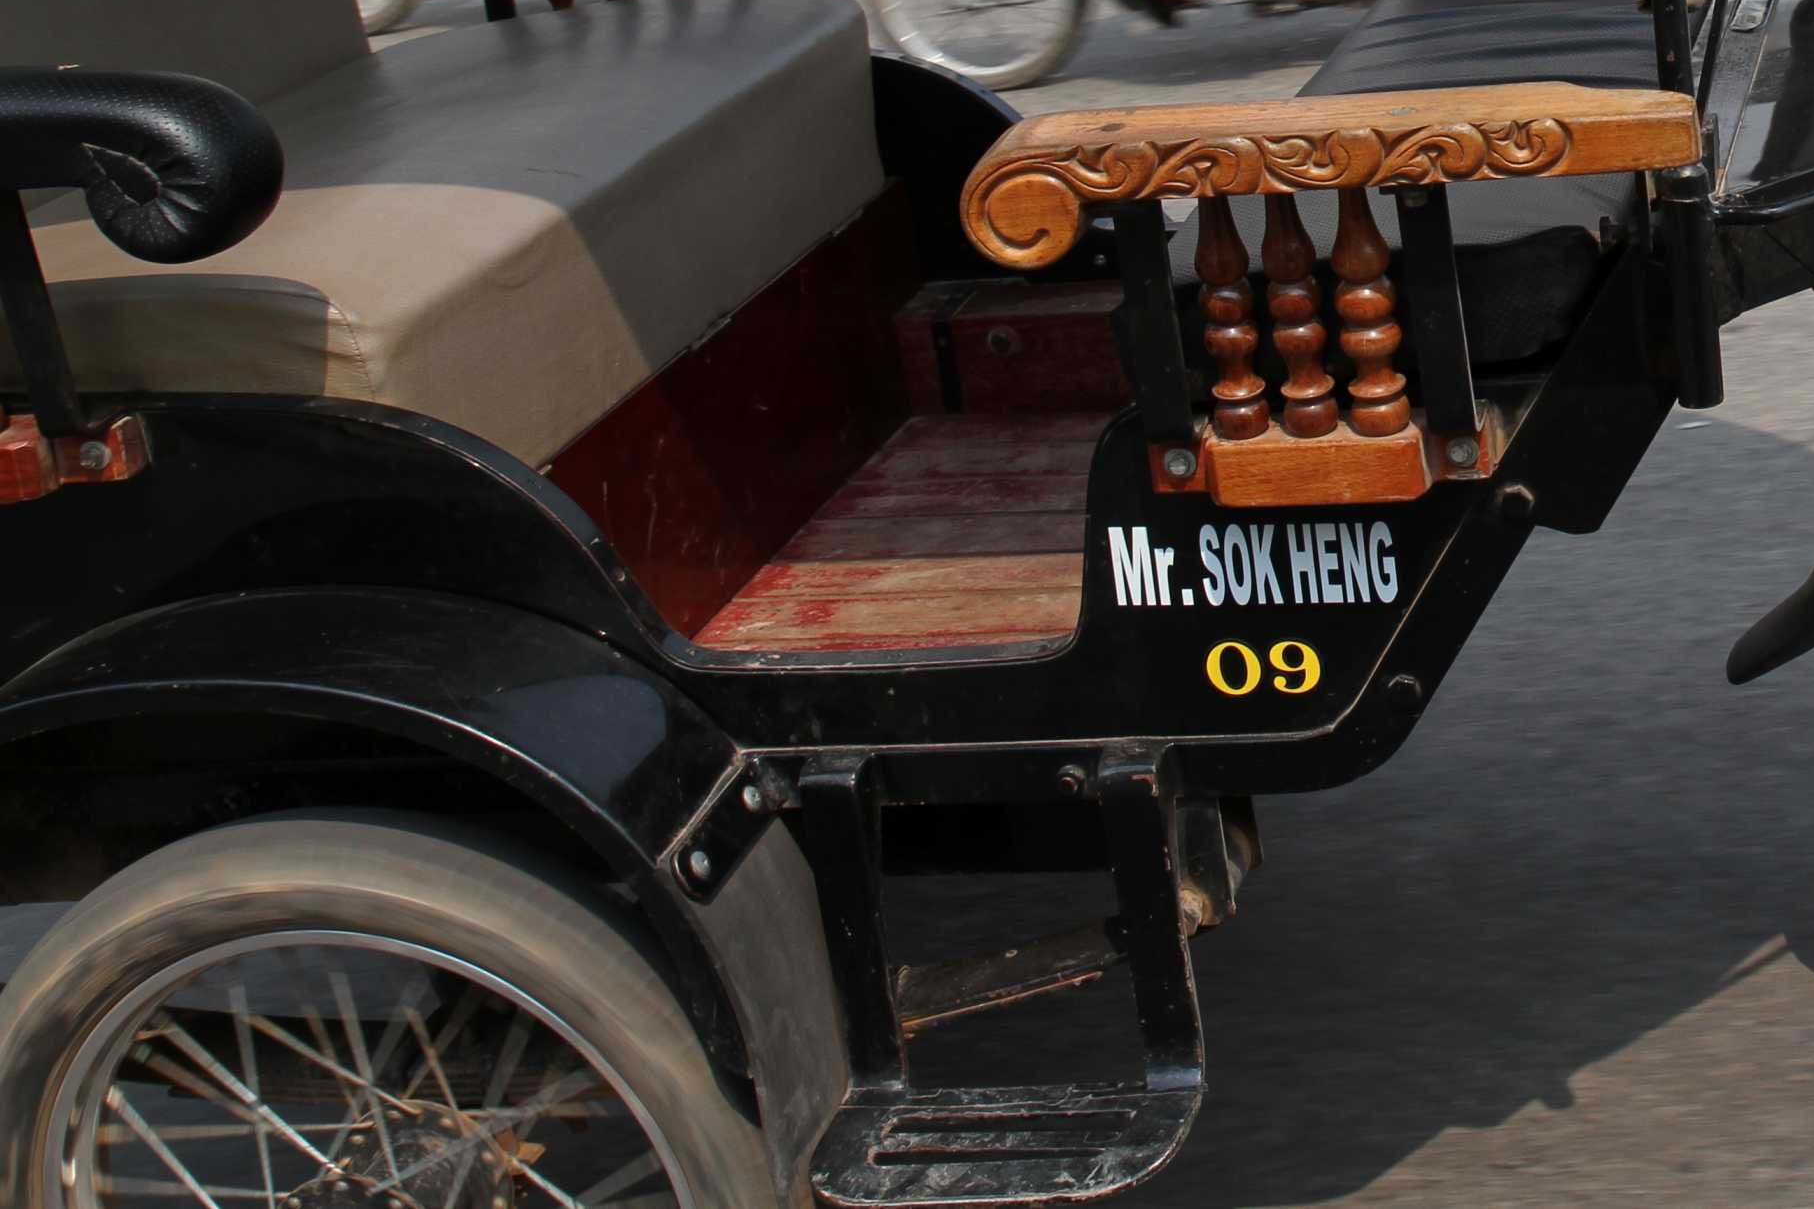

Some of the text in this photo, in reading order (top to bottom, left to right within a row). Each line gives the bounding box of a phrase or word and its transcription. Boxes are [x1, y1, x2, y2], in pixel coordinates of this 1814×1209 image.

[1107, 521, 1399, 606] Mr. SOK HENG
[1206, 641, 1321, 696] 09
